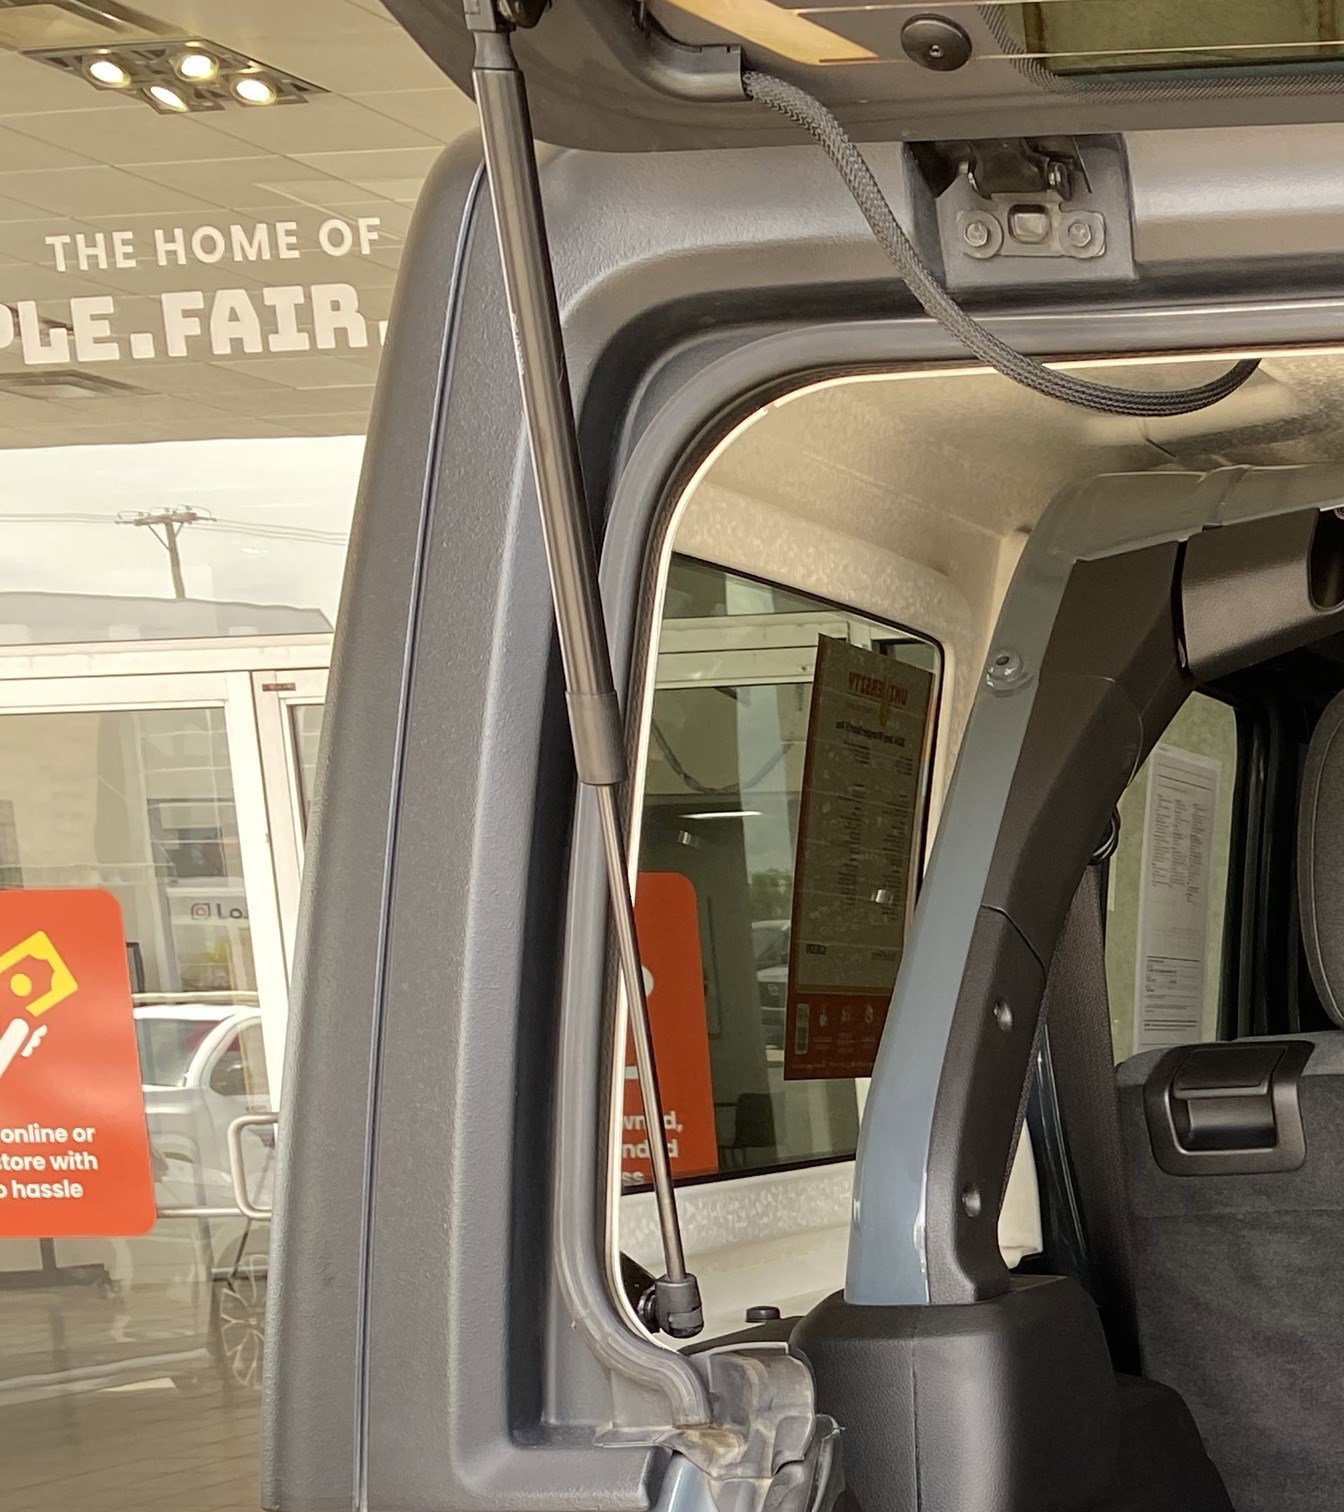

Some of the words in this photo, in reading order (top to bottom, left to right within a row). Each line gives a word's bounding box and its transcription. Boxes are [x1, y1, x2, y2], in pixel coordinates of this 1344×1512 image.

[44, 230, 137, 272] THE
[154, 221, 301, 266] HOME
[318, 217, 381, 257] OF
[0, 1122, 68, 1143] online
[72, 1127, 96, 1143] or
[622, 1139, 679, 1158] ndd
[0, 1152, 46, 1171] tore
[50, 1150, 98, 1170] with
[11, 1179, 84, 1199] hassle
